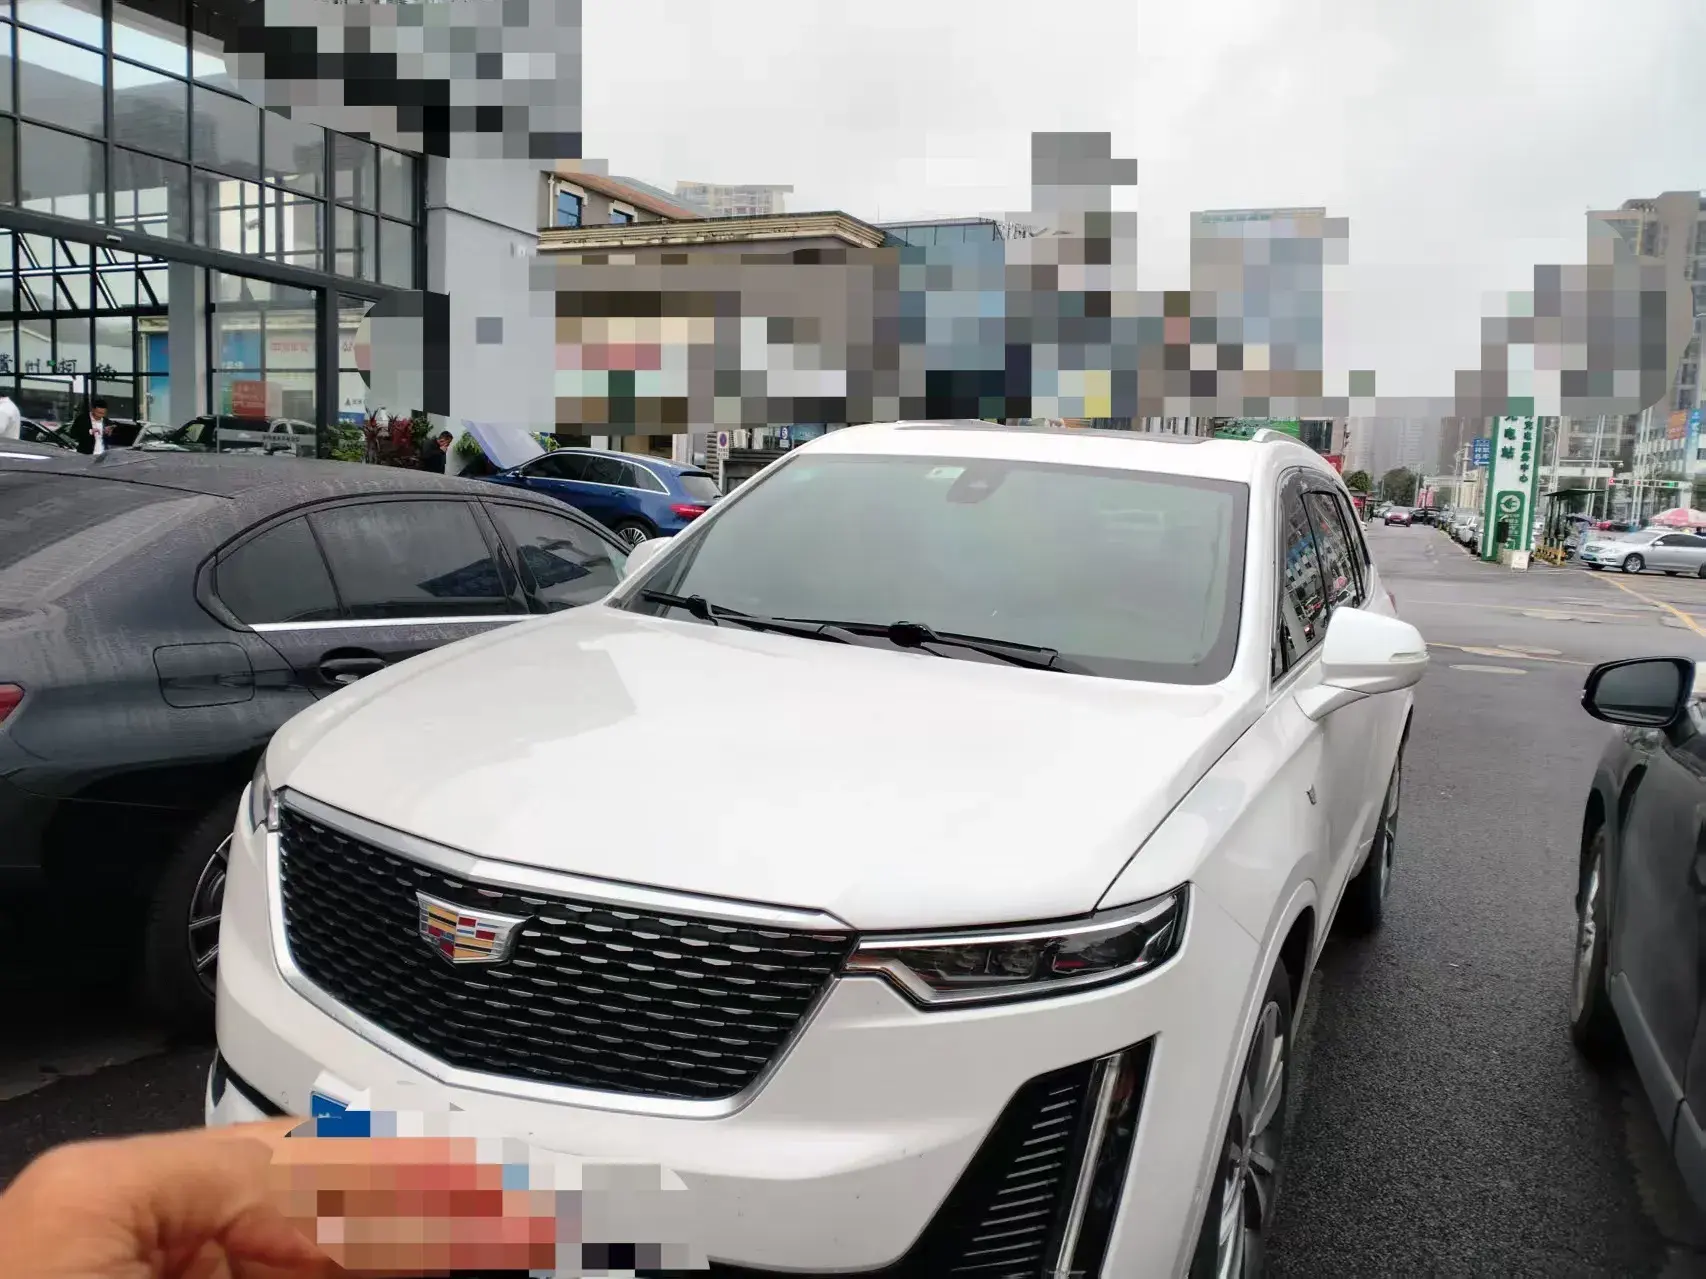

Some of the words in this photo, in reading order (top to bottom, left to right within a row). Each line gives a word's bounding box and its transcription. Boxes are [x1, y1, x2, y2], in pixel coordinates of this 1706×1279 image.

[1519, 416, 1533, 483] 充电服务中心
